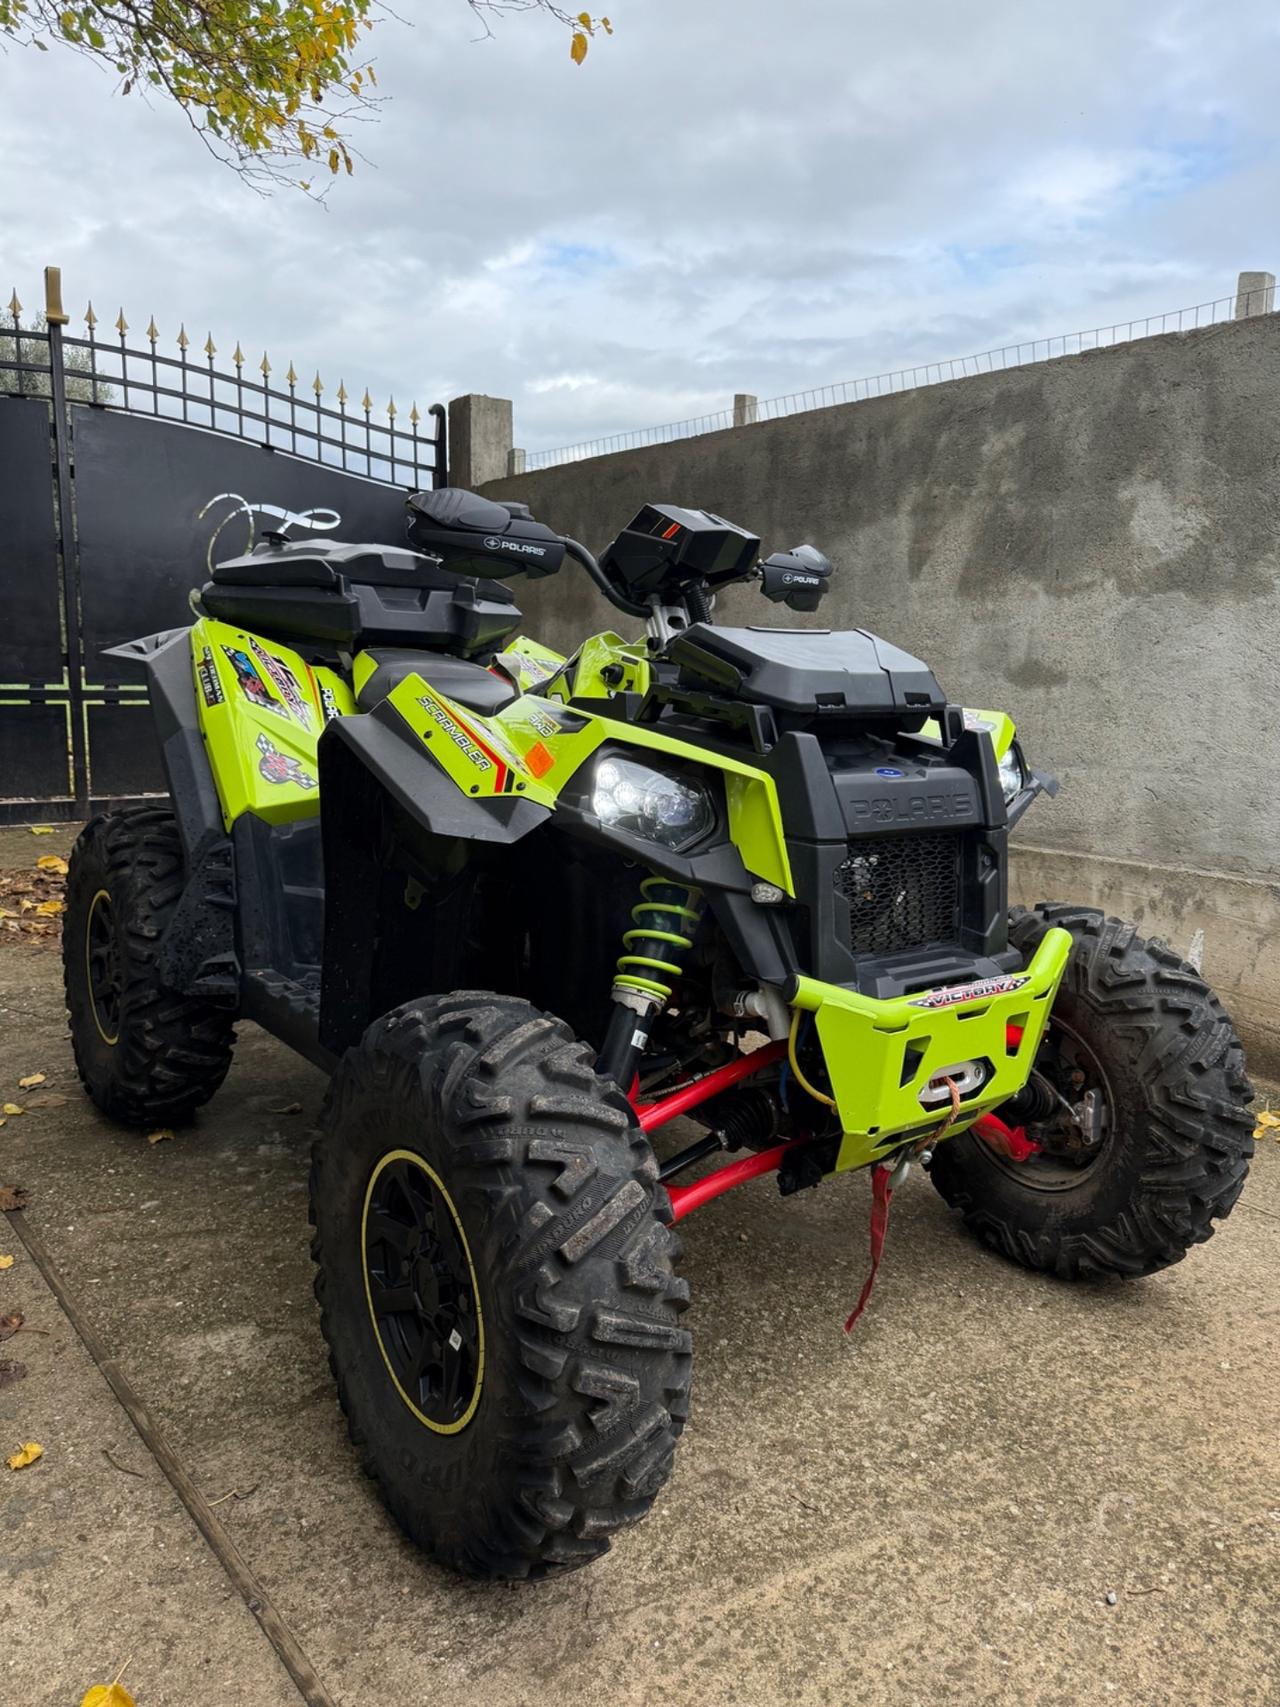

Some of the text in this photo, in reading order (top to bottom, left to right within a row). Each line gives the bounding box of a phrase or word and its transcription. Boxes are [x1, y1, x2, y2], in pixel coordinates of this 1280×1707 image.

[501, 541, 547, 556] POLARIS
[419, 695, 492, 772] SCRAMBLER
[849, 793, 975, 825] POLARIS
[932, 981, 1006, 1005] VICTORY
